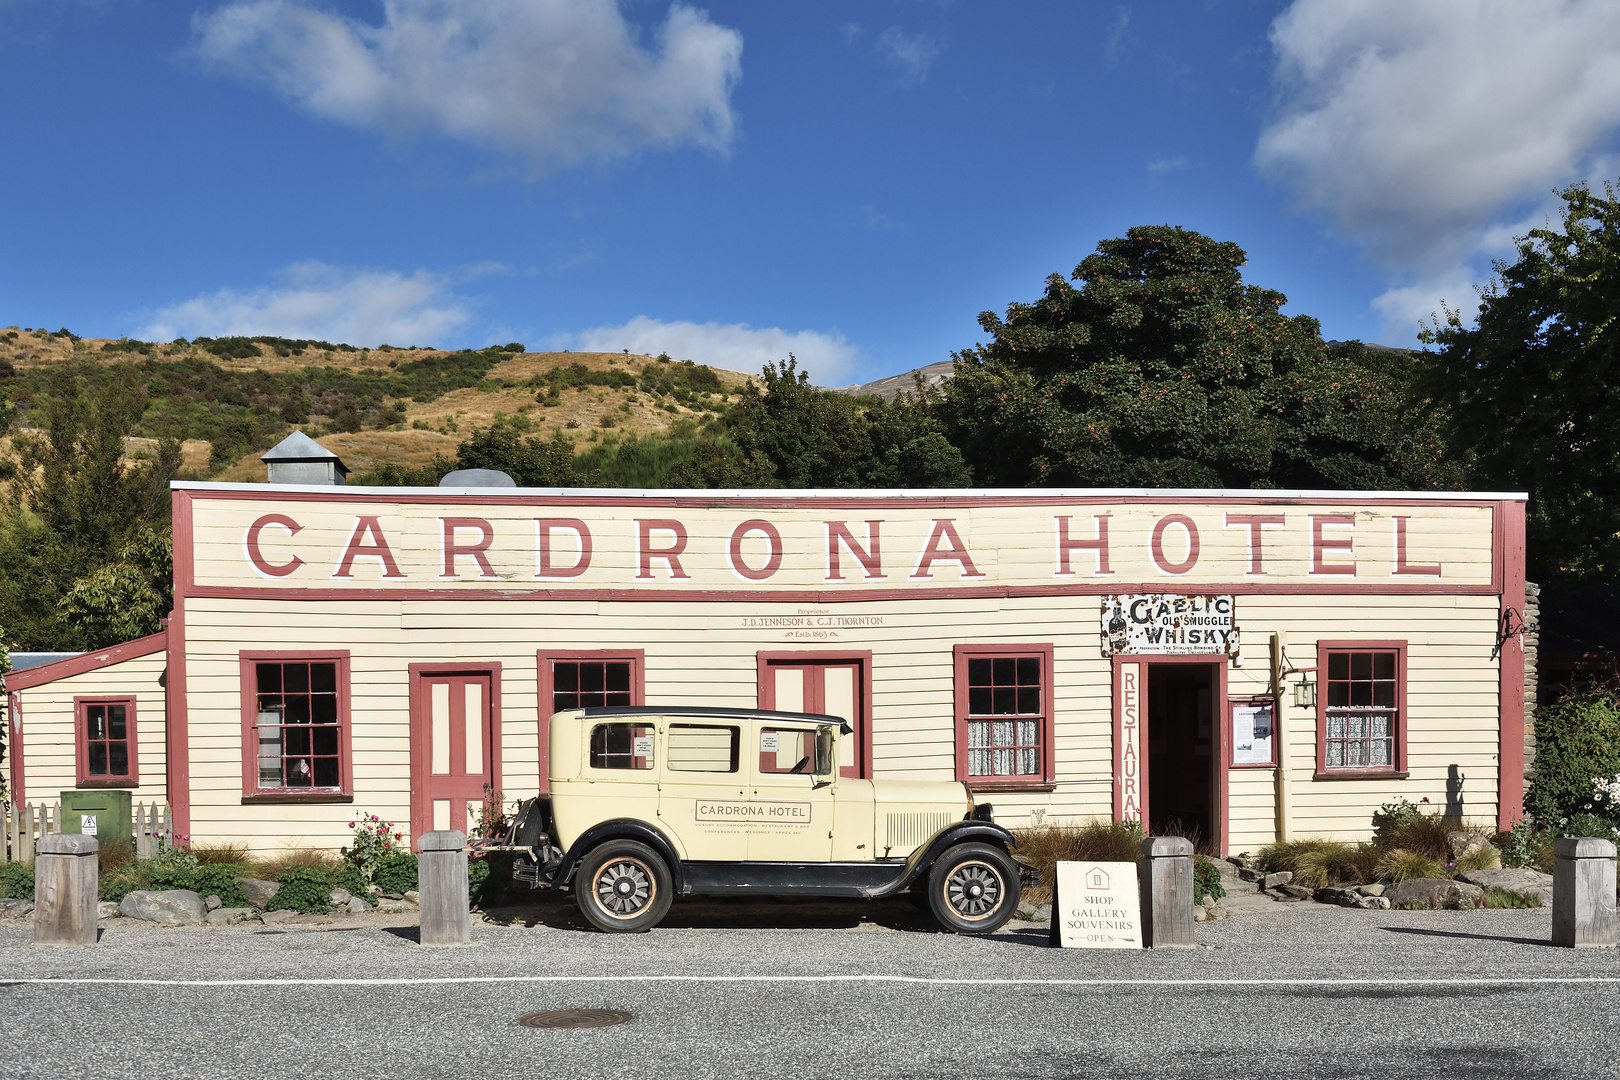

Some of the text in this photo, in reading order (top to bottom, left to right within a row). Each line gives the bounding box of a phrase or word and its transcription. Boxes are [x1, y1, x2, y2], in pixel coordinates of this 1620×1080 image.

[243, 512, 1442, 580] CARDRONA HOTEL
[1130, 599, 1230, 624] GAELIC
[806, 618, 813, 626] &
[1144, 627, 1231, 644] WHISKY
[1123, 673, 1136, 821] RESTAURAN
[700, 805, 806, 816] CARDRONA HOTEL
[1084, 895, 1114, 905] SHOP
[1071, 908, 1128, 918] GALLERY
[1067, 920, 1133, 930] SOUVENIRS
[1086, 934, 1115, 942] OPEN
